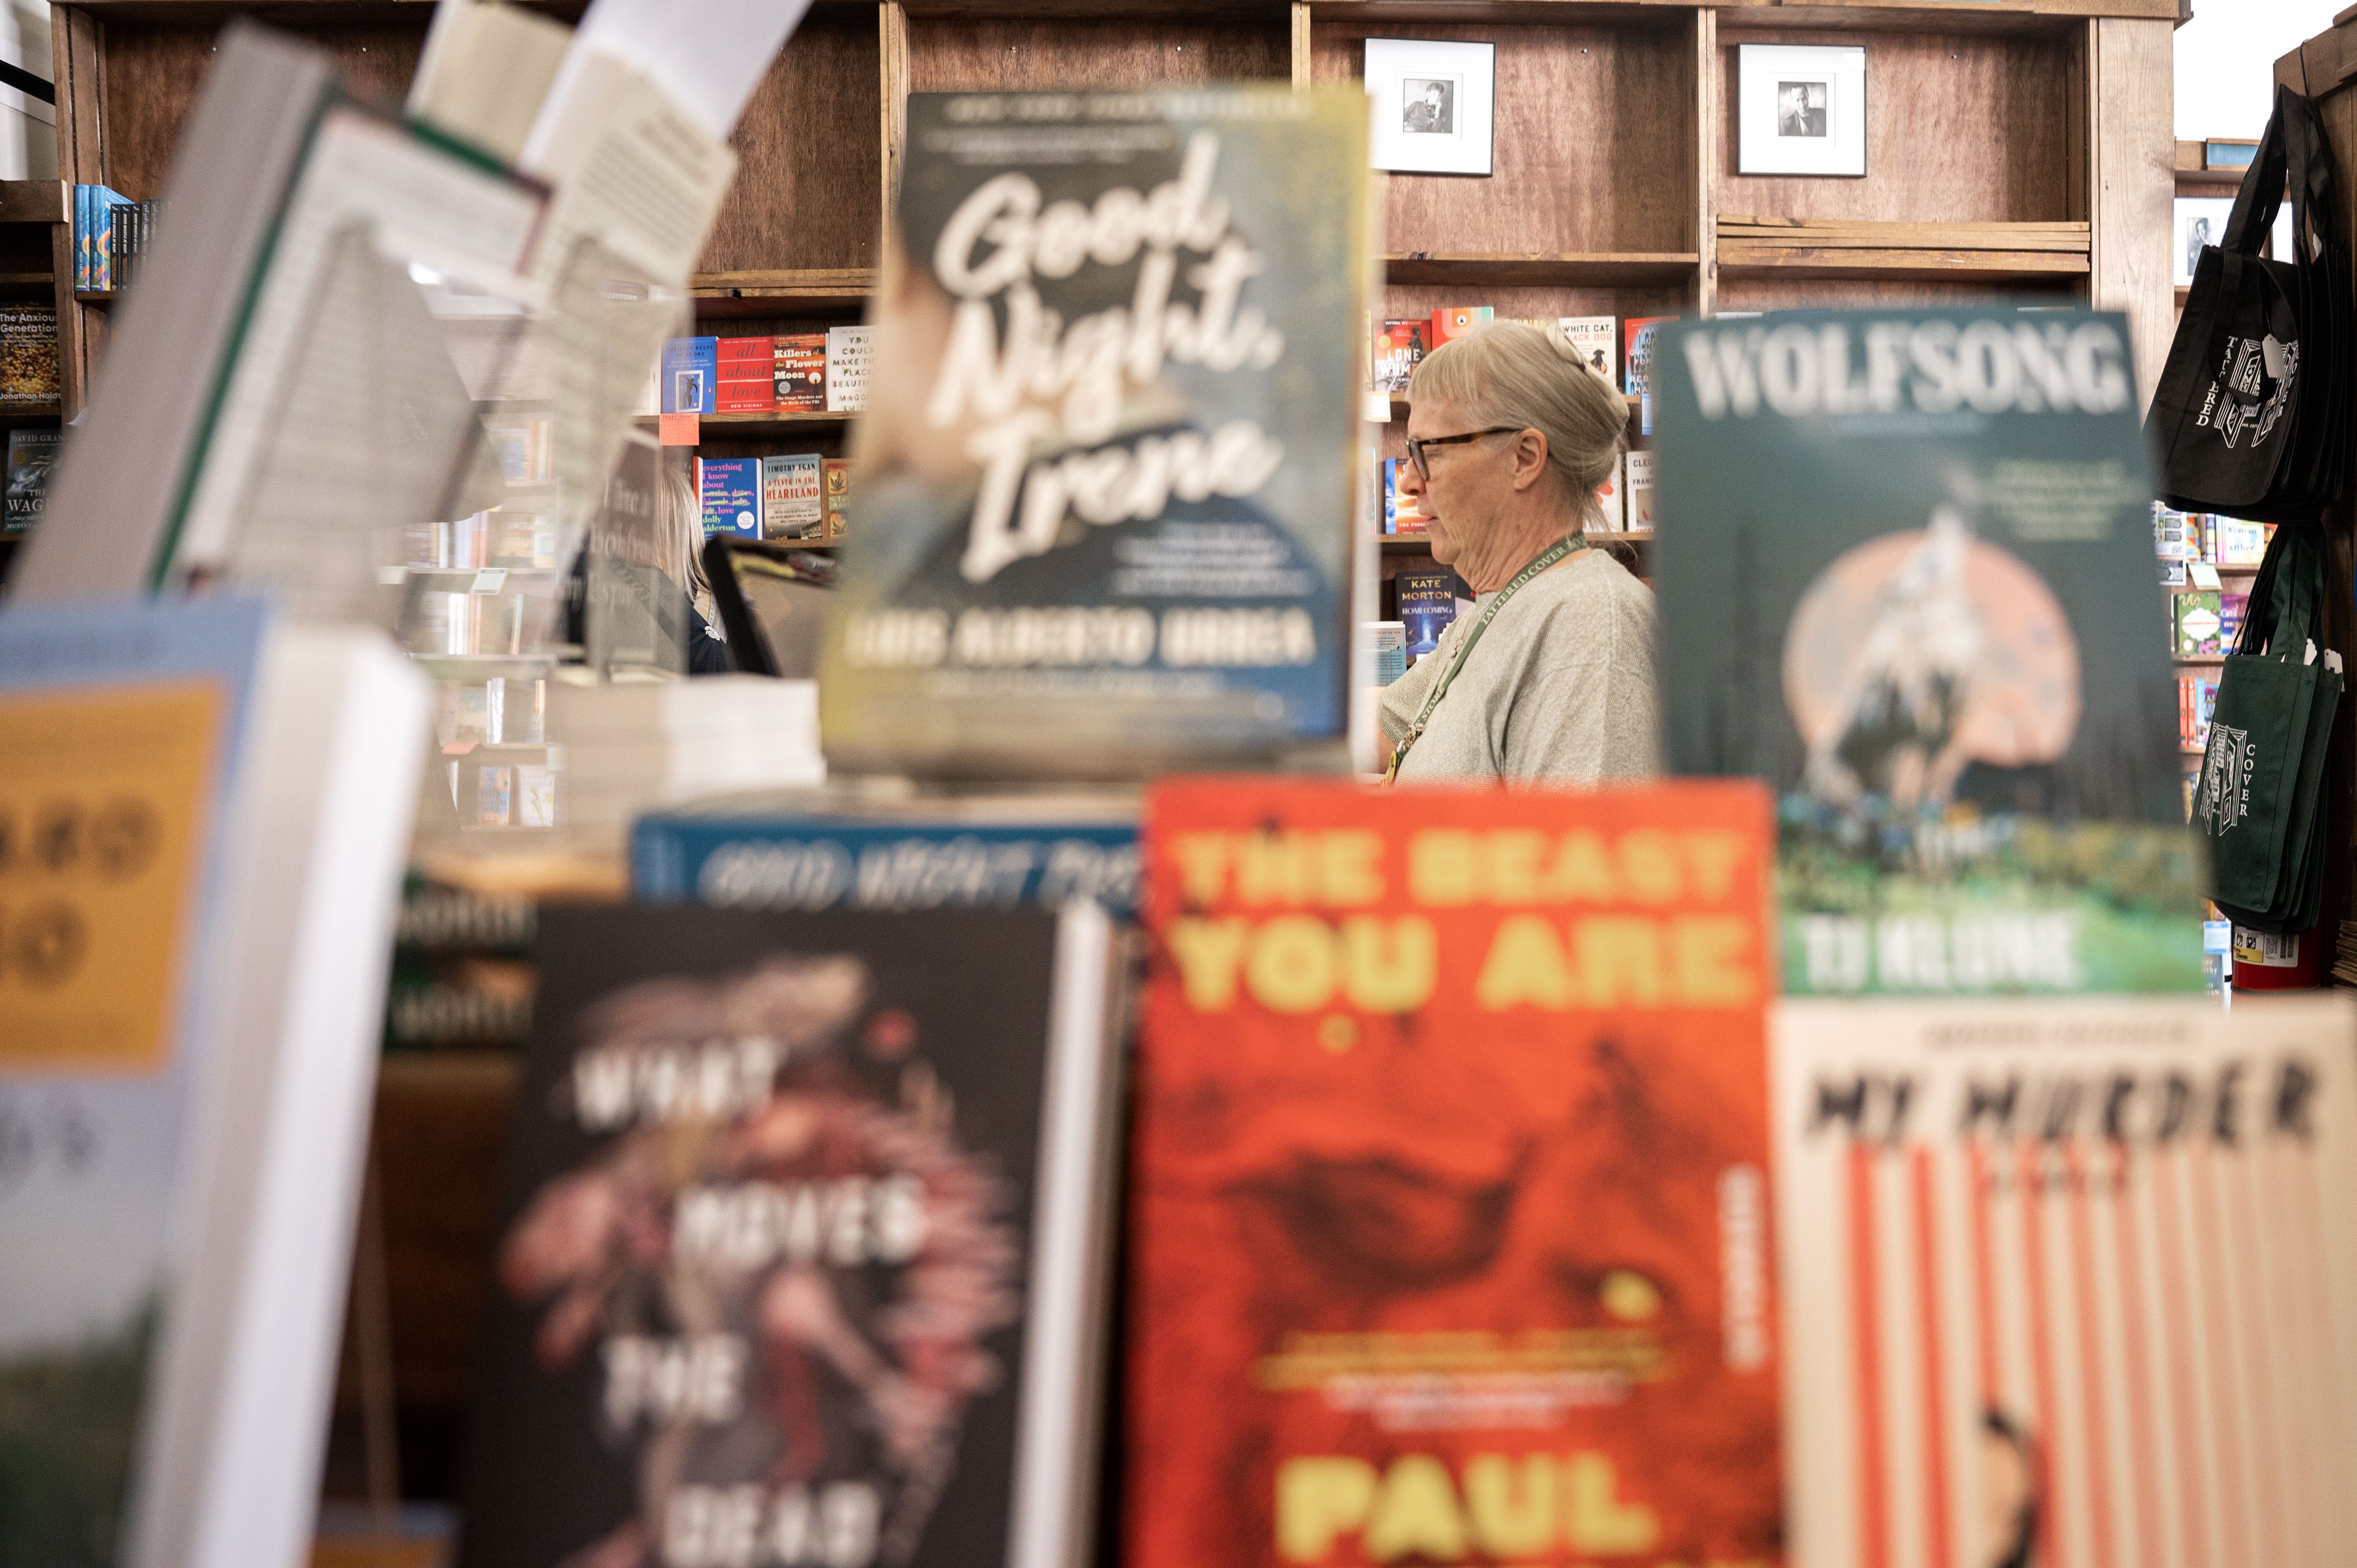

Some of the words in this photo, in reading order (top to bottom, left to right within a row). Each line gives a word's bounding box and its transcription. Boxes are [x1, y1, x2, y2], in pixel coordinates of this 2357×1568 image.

[0, 324, 58, 333] Generation
[1594, 325, 1612, 333] CAT,
[737, 344, 755, 357] all
[774, 349, 812, 358] Killers
[1387, 349, 1420, 361] LONE
[786, 360, 824, 368] Flower
[726, 364, 766, 378] about
[774, 371, 805, 380] Moon
[1684, 320, 2130, 421] WOLFSONG
[732, 384, 761, 398] love
[702, 463, 742, 472] everything
[766, 487, 818, 499] HEARTLAND
[703, 515, 722, 524] dolly
[1412, 580, 1441, 589] KATE
[1480, 573, 1528, 625] TATTERED
[1528, 547, 1566, 576] COVER
[1402, 592, 1452, 600] MORTON
[1402, 606, 1453, 615] HOMECOMING
[2239, 744, 2255, 816] COVER
[1172, 828, 1385, 907] THE
[1410, 827, 1754, 907] BEAST
[1172, 914, 1438, 1014] YOU
[1475, 914, 1758, 1013] ARE
[1277, 1452, 1661, 1562] PAUL
